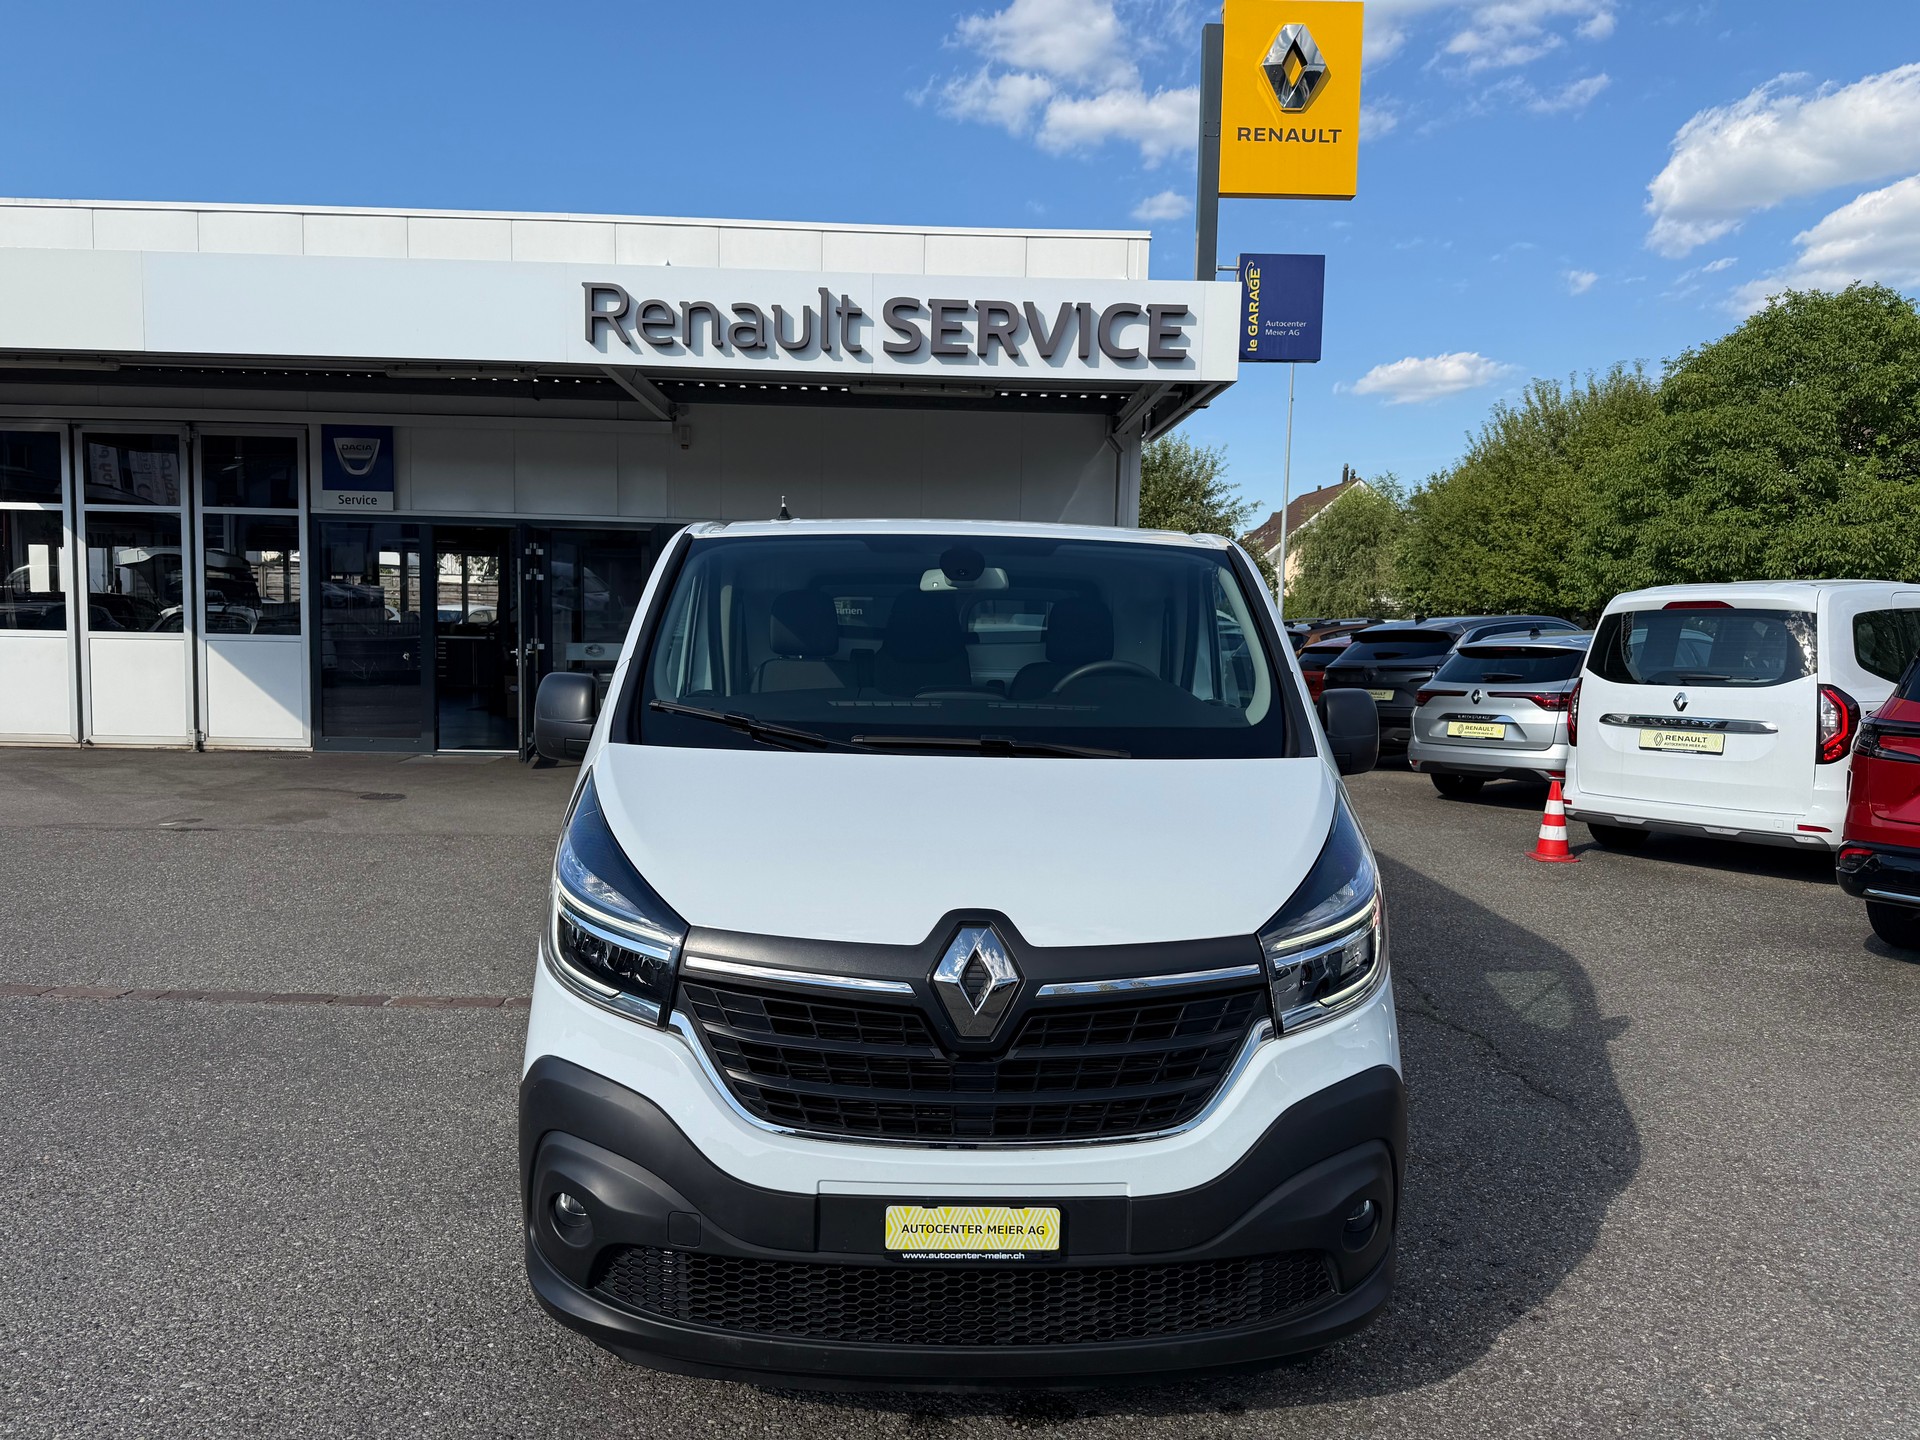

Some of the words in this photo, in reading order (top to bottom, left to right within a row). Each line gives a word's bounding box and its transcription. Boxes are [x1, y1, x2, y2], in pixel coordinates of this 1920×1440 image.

[1236, 127, 1343, 144] RENAULT
[1248, 268, 1260, 336] GARAGE
[581, 281, 864, 353] Renault
[882, 296, 1189, 361] SERVICE
[1265, 320, 1307, 328] Autocenter
[1247, 339, 1258, 352] le
[337, 494, 378, 505] Service
[1665, 734, 1708, 743] RENAULT
[901, 1224, 983, 1235] AUTOCENTER
[987, 1225, 1025, 1235] MEIER
[1027, 1225, 1045, 1236] AG
[902, 1252, 1025, 1261] www.autocenter-meier.ch
